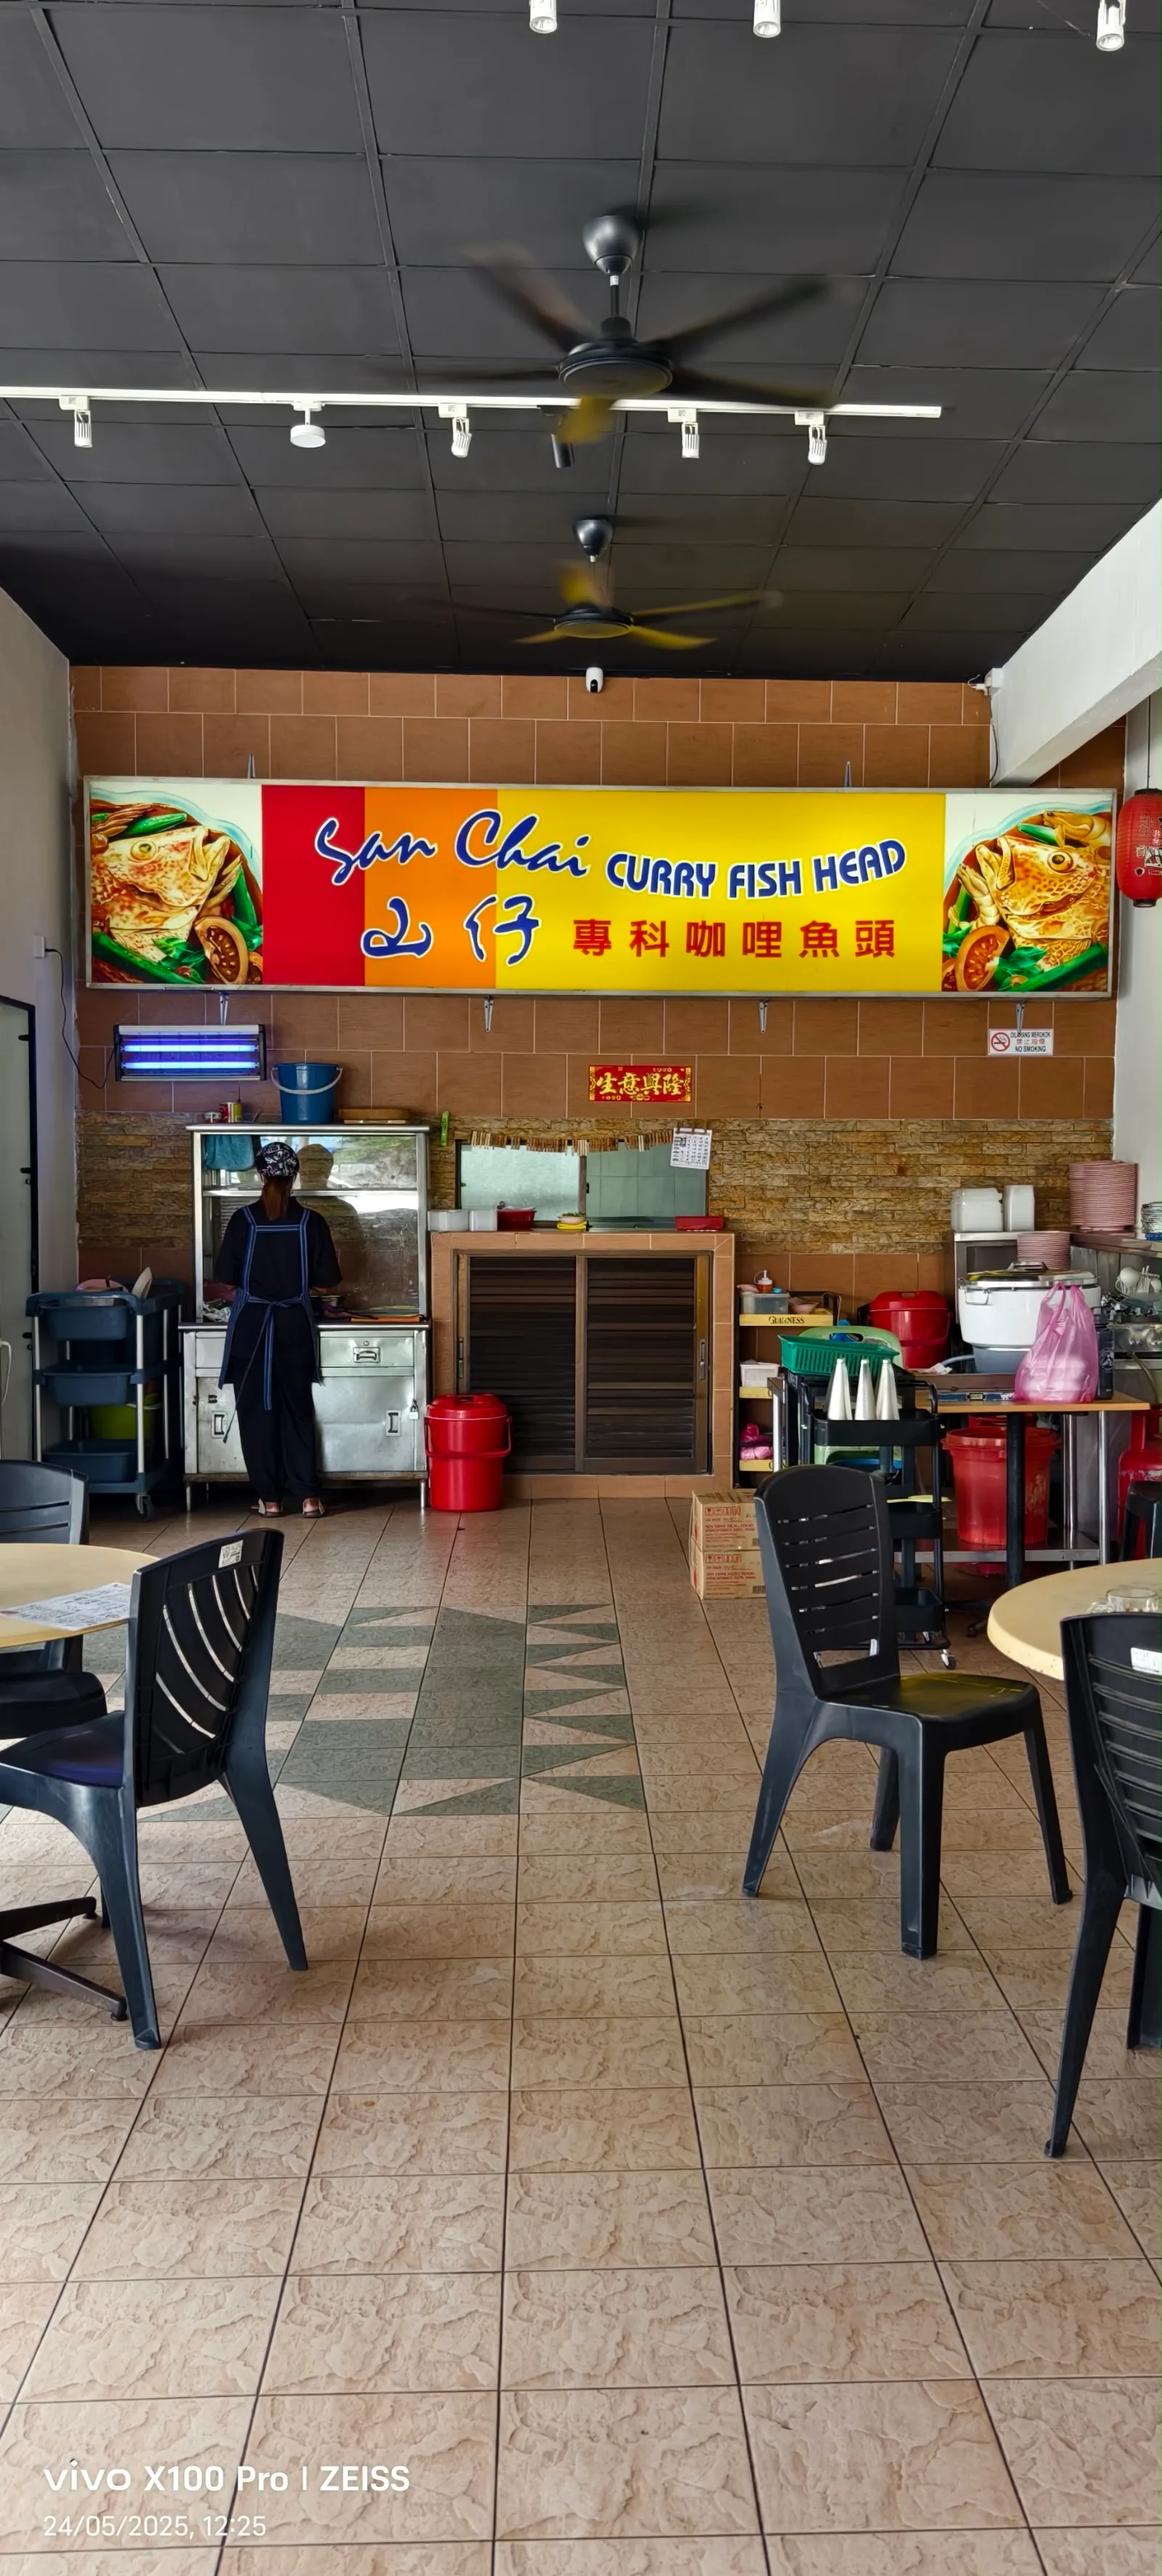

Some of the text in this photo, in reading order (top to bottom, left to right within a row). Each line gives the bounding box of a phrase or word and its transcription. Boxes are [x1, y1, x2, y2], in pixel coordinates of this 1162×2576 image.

[316, 810, 905, 898] San Chai CURRY FISH HEAD
[574, 919, 894, 957] 專科咖哩魚頭
[596, 1072, 684, 1095] 生意興隆
